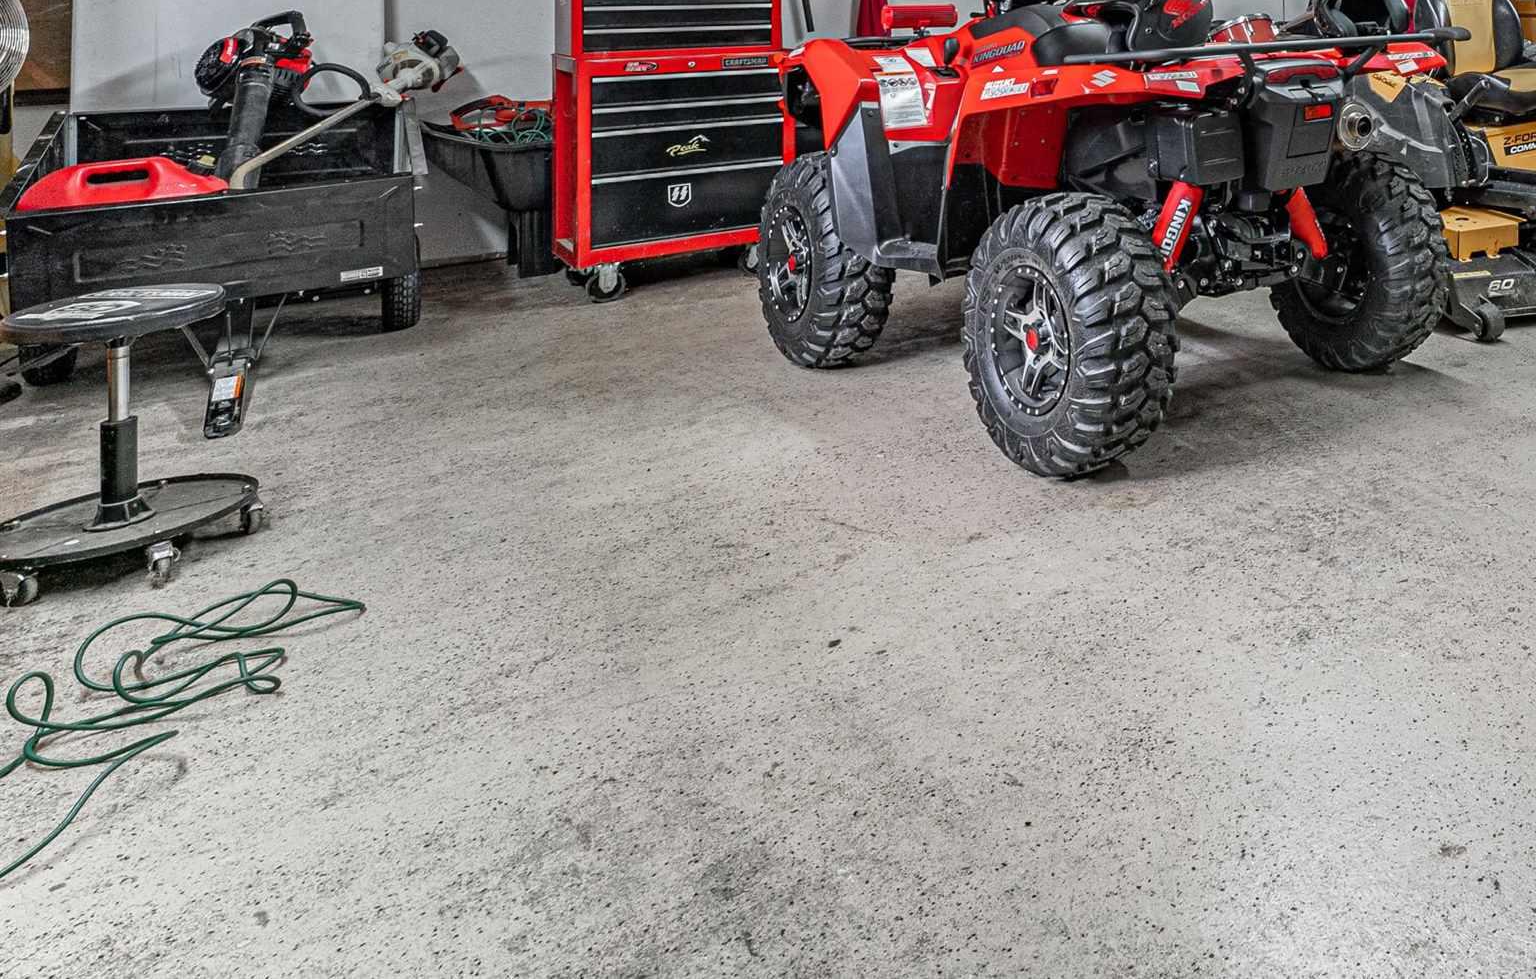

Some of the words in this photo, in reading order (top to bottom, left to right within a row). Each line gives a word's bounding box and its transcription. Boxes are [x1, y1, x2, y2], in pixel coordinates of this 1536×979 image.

[972, 39, 1026, 63] KINGQUAD
[725, 56, 768, 67] CRAFTSMAN
[666, 140, 703, 157] Peak
[1488, 278, 1515, 291] 60
